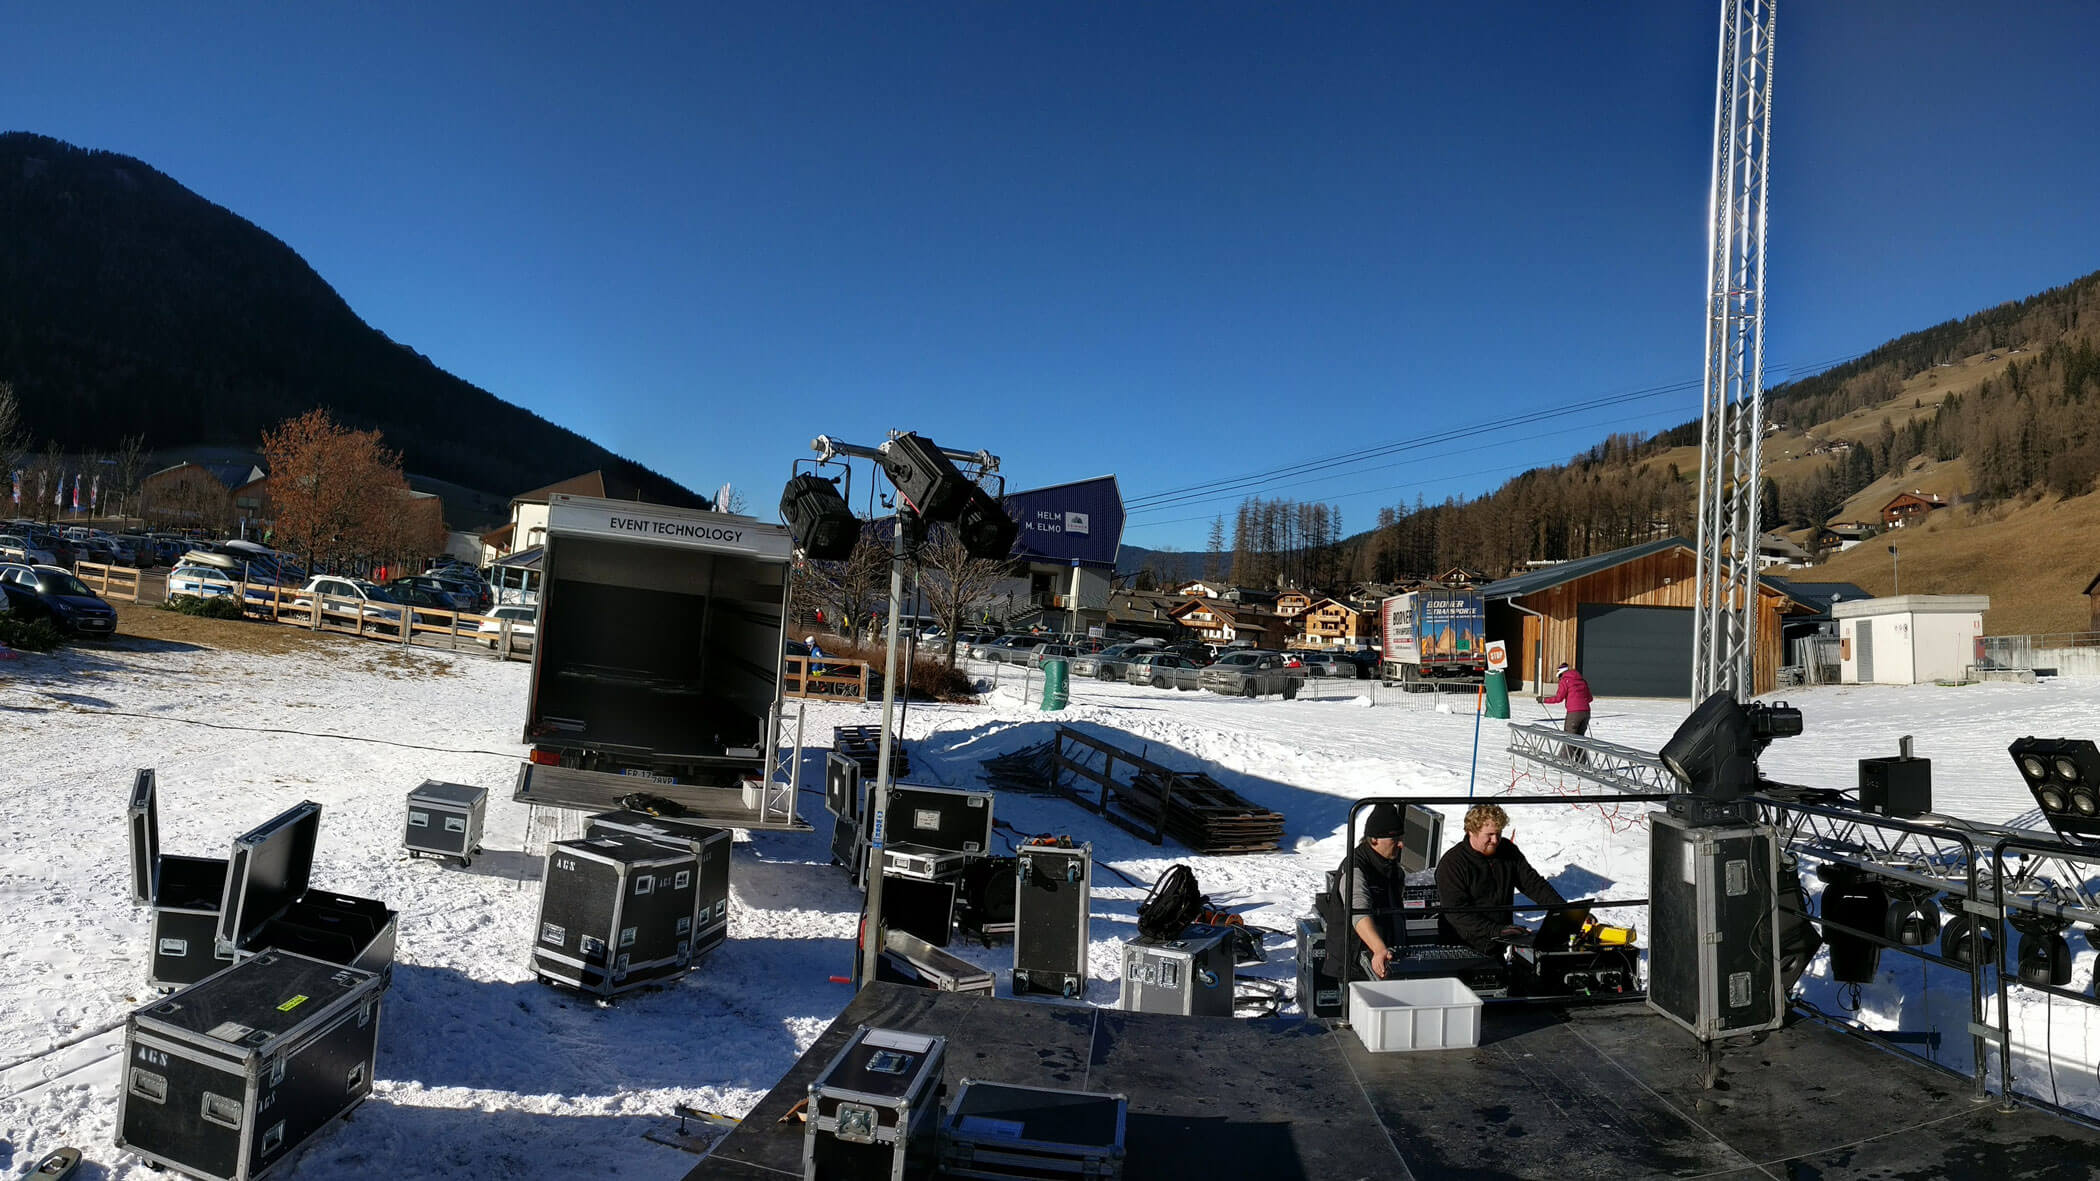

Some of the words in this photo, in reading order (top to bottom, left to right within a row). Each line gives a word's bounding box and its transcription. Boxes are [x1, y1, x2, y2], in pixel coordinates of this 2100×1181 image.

[1037, 511, 1061, 520] HELM
[610, 517, 650, 532] EVENT
[652, 521, 742, 542] TECHNOLOGY
[1025, 521, 1035, 530] M.
[1037, 522, 1061, 533] ELMO
[1426, 600, 1465, 608] BODNER
[556, 858, 576, 872] AGS
[138, 1047, 168, 1067] AGS
[257, 1090, 277, 1113] AGS
